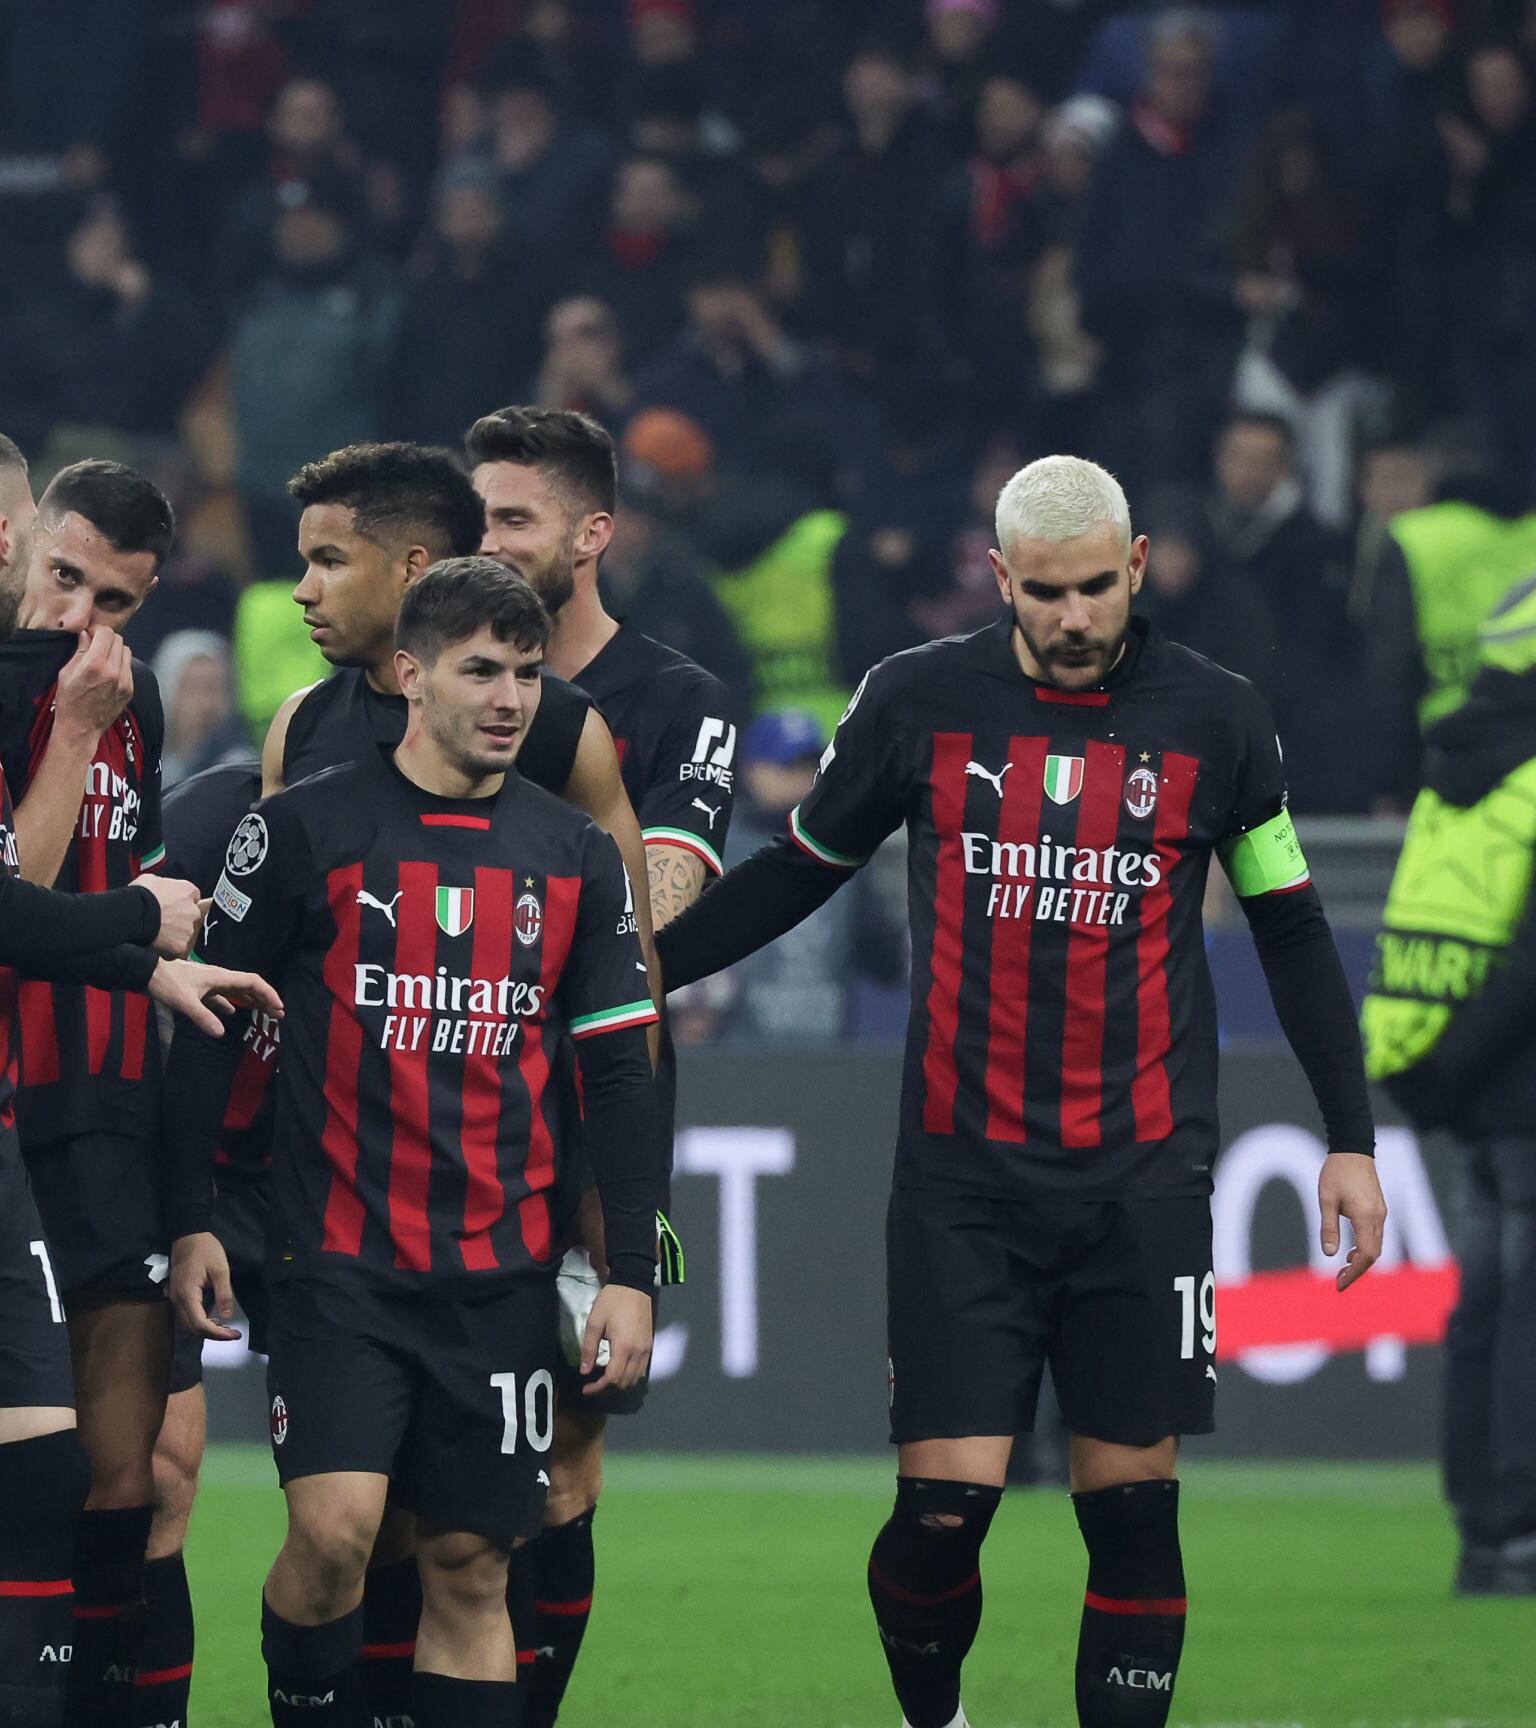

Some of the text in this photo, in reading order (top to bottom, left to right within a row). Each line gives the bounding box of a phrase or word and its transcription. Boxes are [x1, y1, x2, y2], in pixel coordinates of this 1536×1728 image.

[75, 803, 105, 838] LY
[960, 832, 1161, 887] Emirates
[986, 884, 1130, 925] FLY BETTER
[354, 963, 545, 1016] Emirates
[380, 1015, 519, 1056] FLY BETTER
[29, 1240, 66, 1323] 1
[1173, 1270, 1216, 1359] 19
[490, 1368, 554, 1455] 10
[1106, 1667, 1173, 1692] ACM
